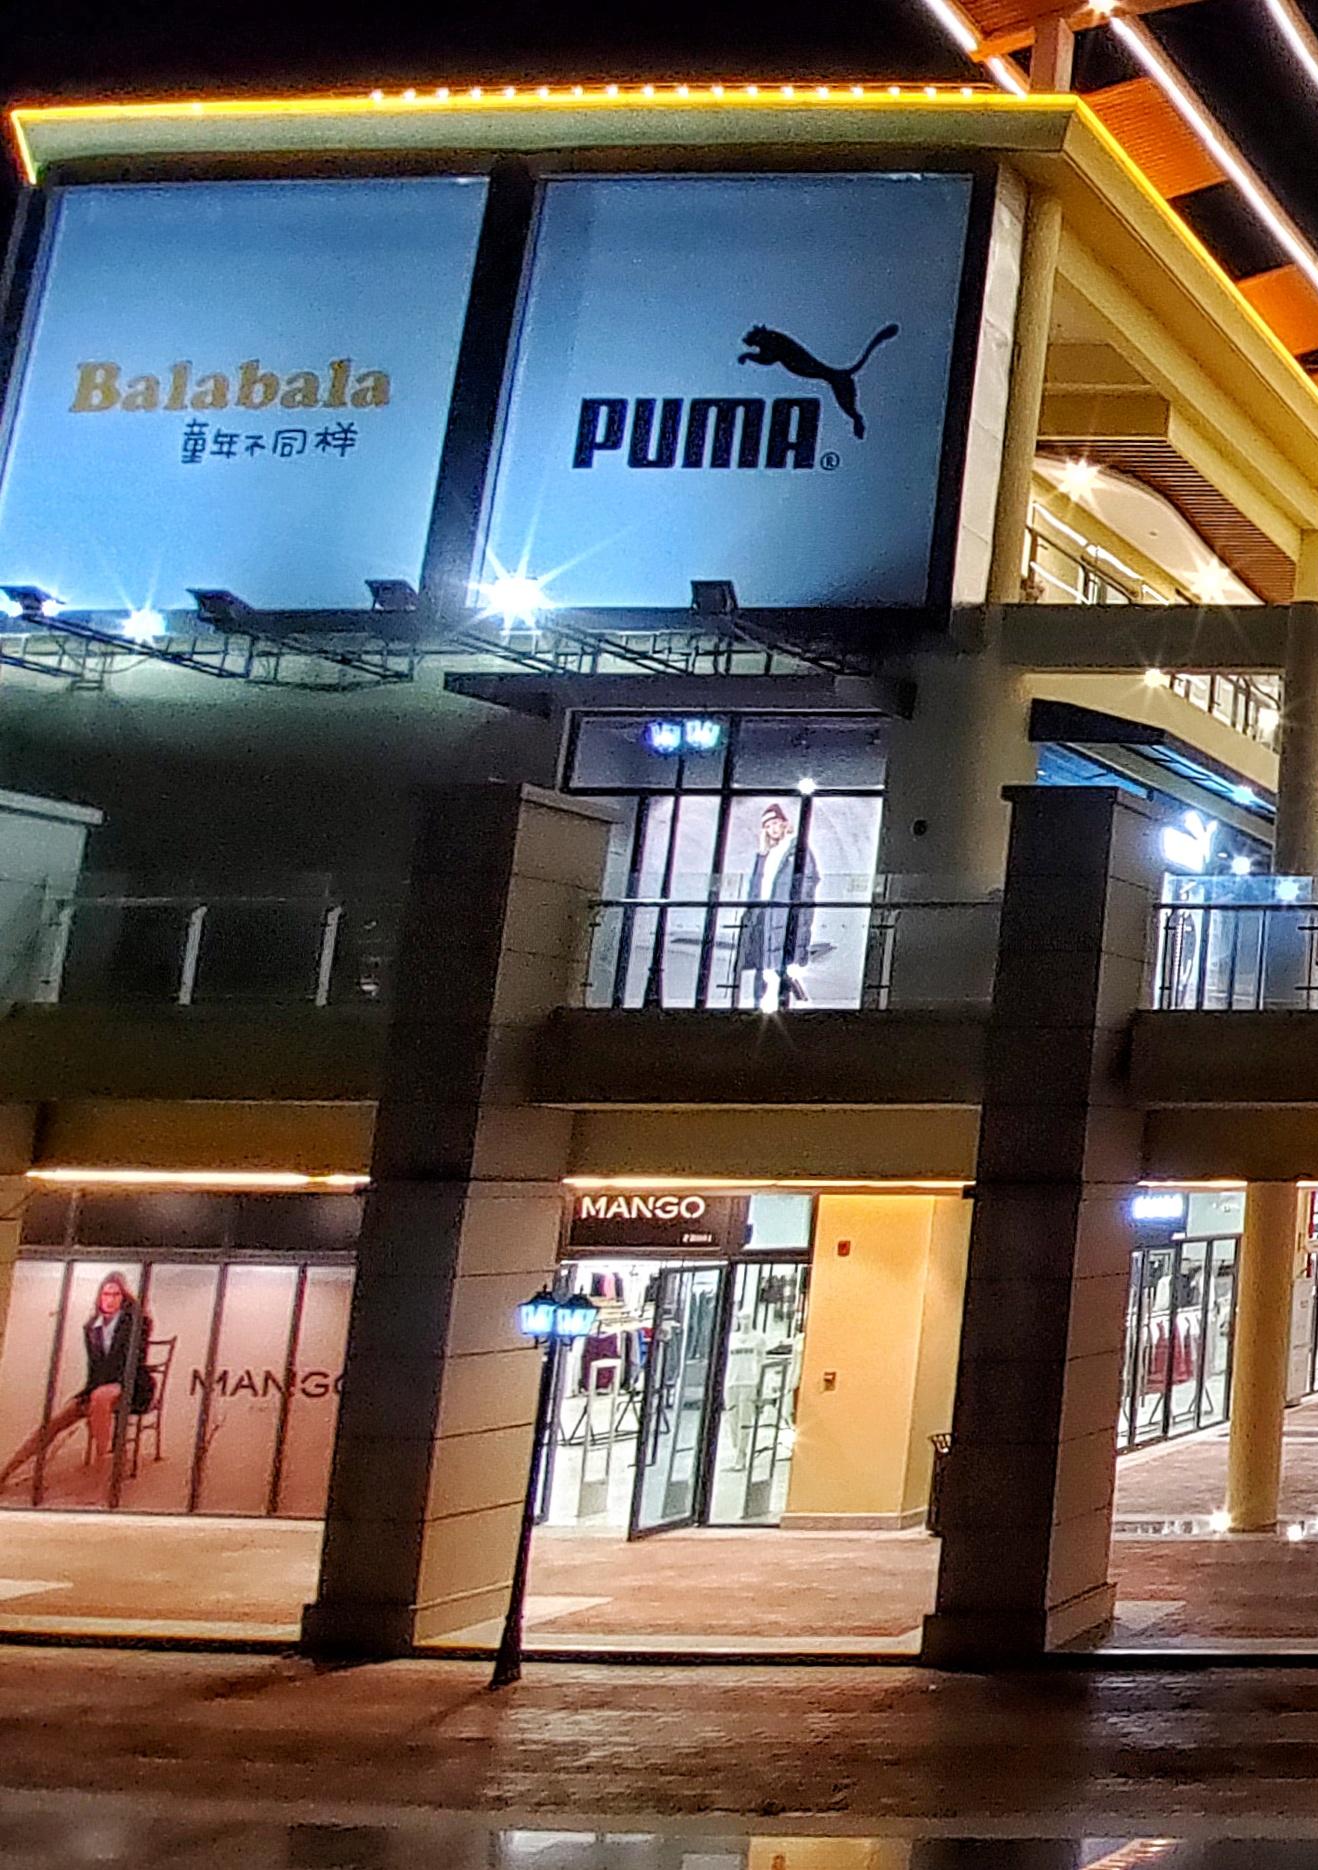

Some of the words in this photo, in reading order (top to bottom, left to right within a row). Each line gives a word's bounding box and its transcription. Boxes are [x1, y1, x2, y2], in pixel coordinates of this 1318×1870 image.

[68, 358, 392, 412] Balabala
[181, 418, 358, 464] 童年不同样
[581, 1196, 706, 1219] MANGO
